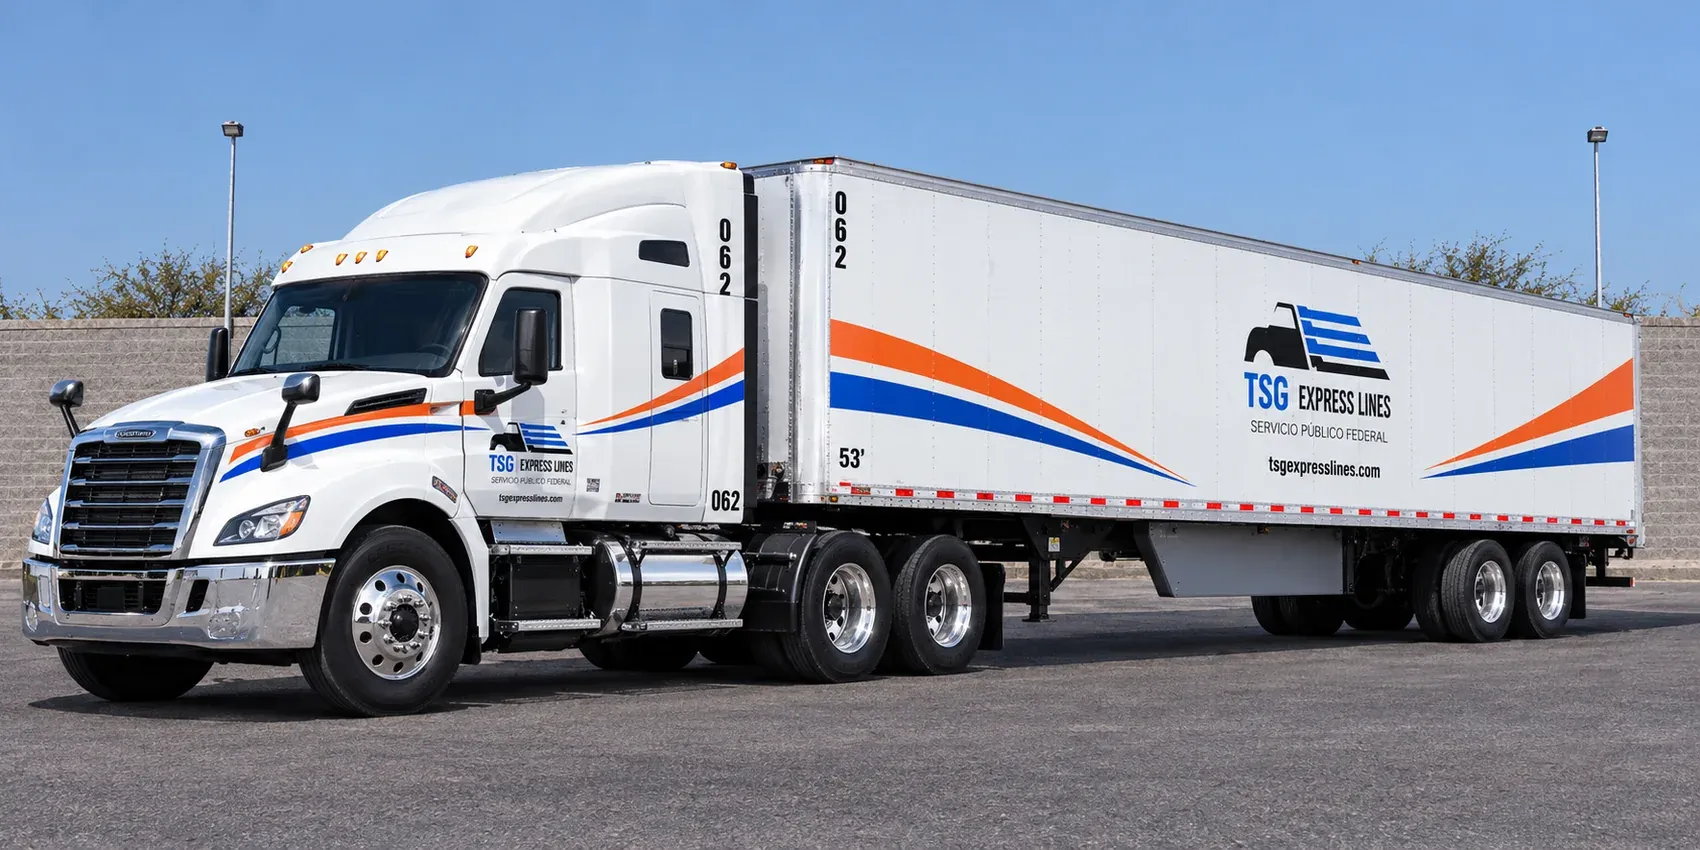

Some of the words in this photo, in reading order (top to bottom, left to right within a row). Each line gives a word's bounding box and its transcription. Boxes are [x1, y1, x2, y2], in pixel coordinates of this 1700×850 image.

[835, 191, 847, 269] 062
[719, 218, 731, 296] 062
[1244, 372, 1289, 411] TSG
[1299, 385, 1354, 415] EXPRESS
[1358, 392, 1391, 418] LINES
[1251, 419, 1298, 436] SERVICIO
[1301, 421, 1344, 440] PÚBLICO
[1346, 428, 1388, 443] FEDERAL
[489, 454, 514, 472] TSG
[520, 459, 552, 472] EXPRESS
[554, 461, 573, 473] LINES
[1269, 456, 1381, 478] tsgexpresslines.com
[491, 476, 518, 484] SERVICIO
[547, 478, 571, 486] FEDERAL
[499, 493, 563, 503] tsgexpresslines.com
[711, 489, 740, 511] 062
